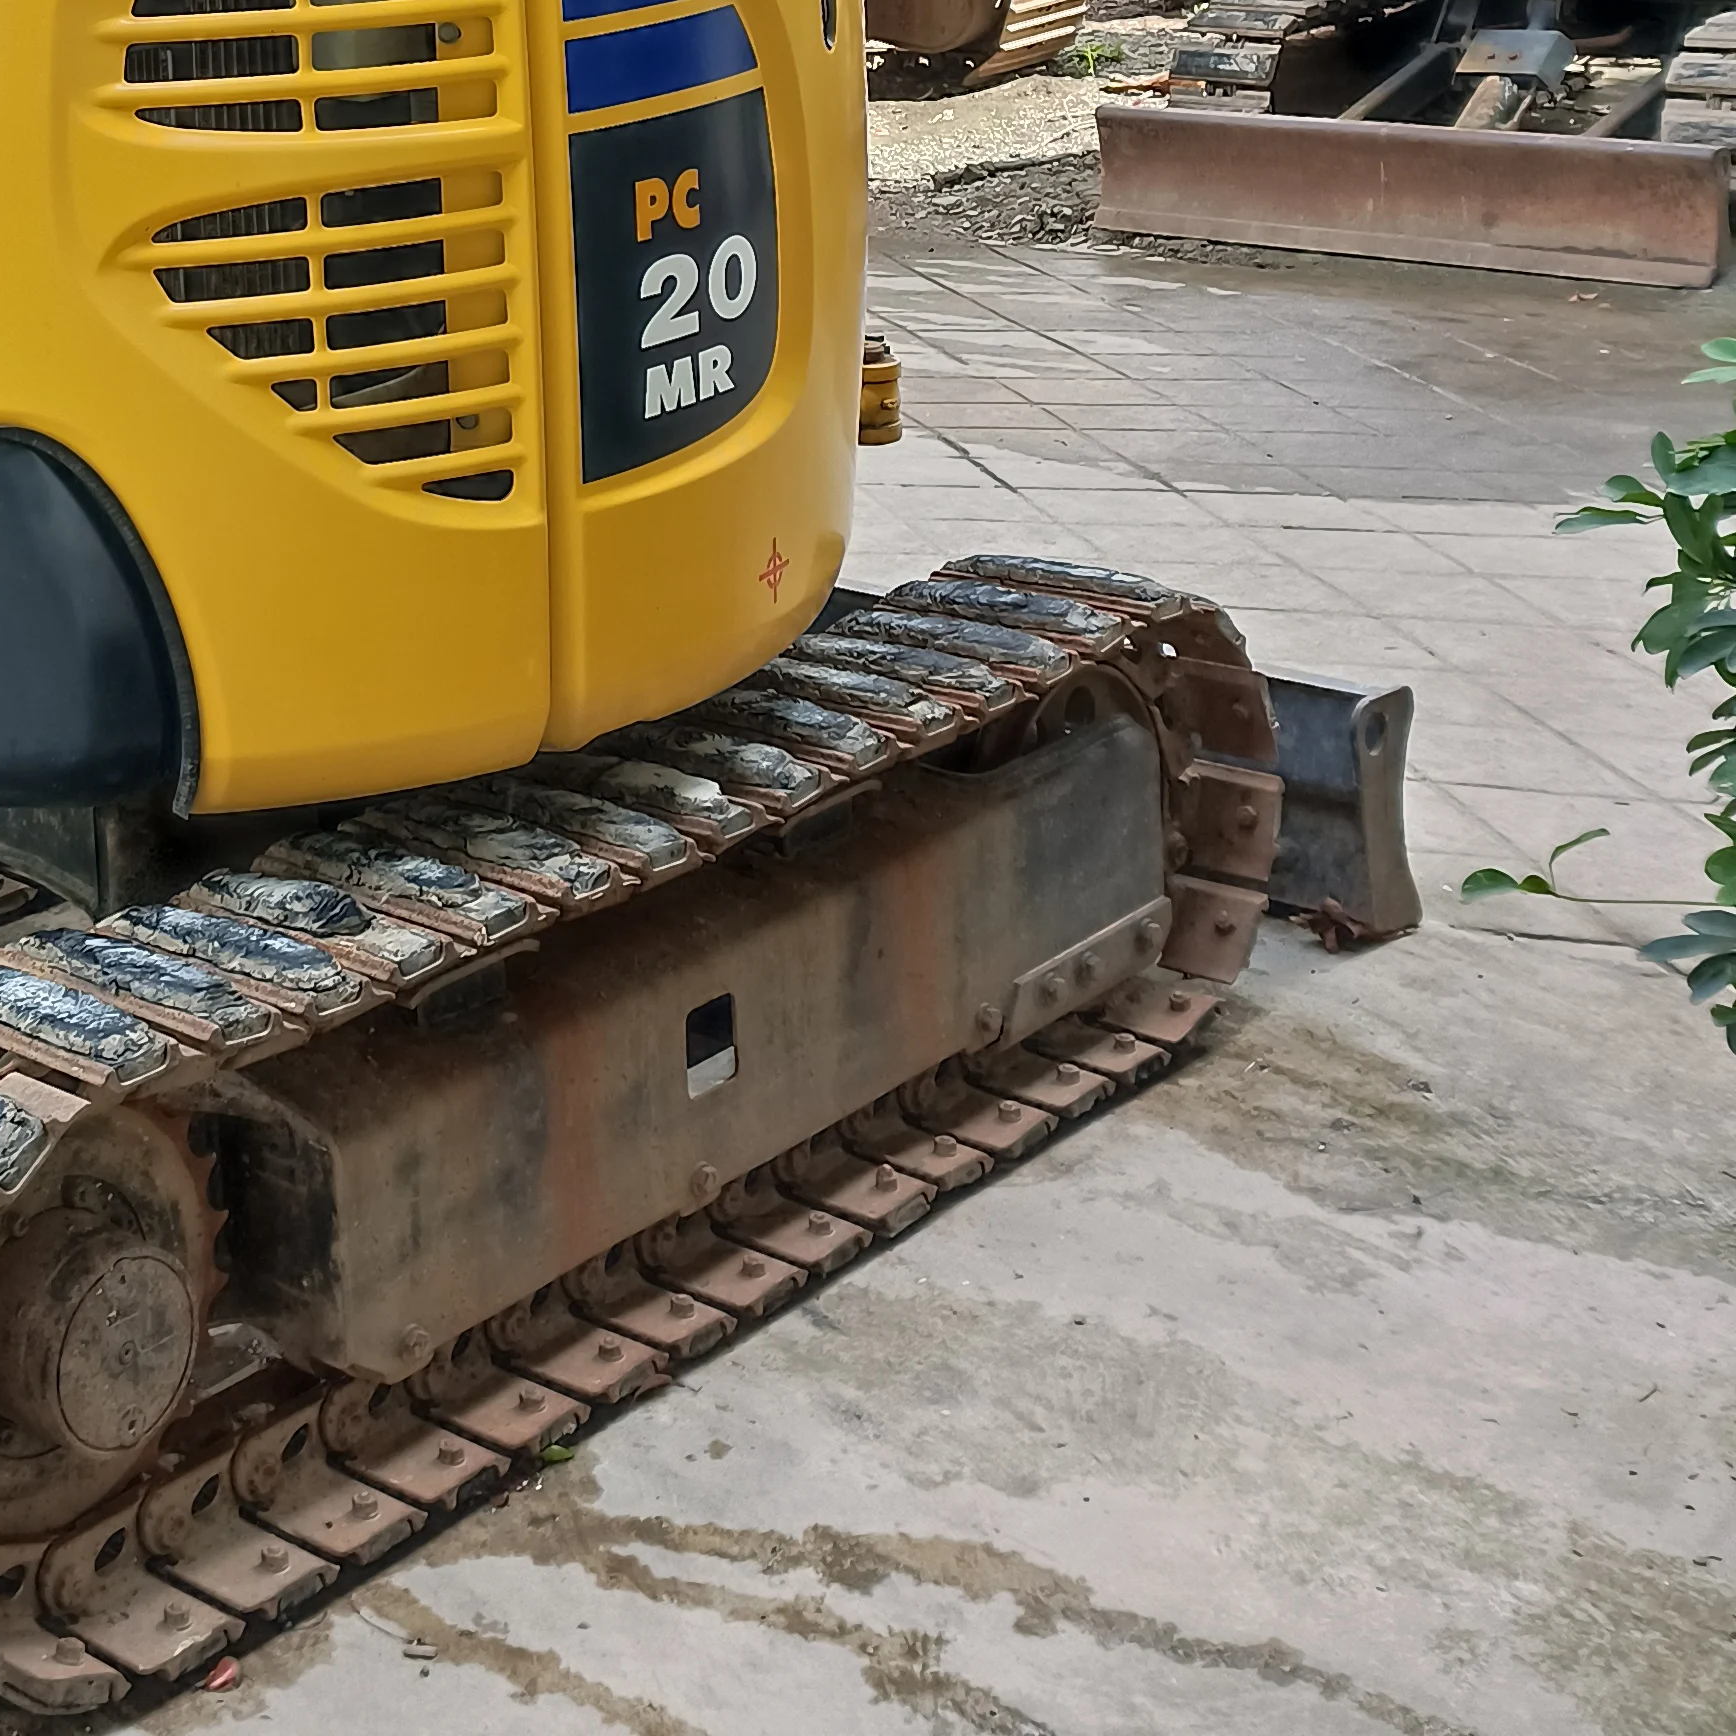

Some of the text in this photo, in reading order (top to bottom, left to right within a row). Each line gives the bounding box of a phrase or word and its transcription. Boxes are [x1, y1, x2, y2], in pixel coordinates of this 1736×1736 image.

[635, 168, 700, 242] PC
[640, 234, 757, 349] 20
[644, 344, 735, 420] MR
